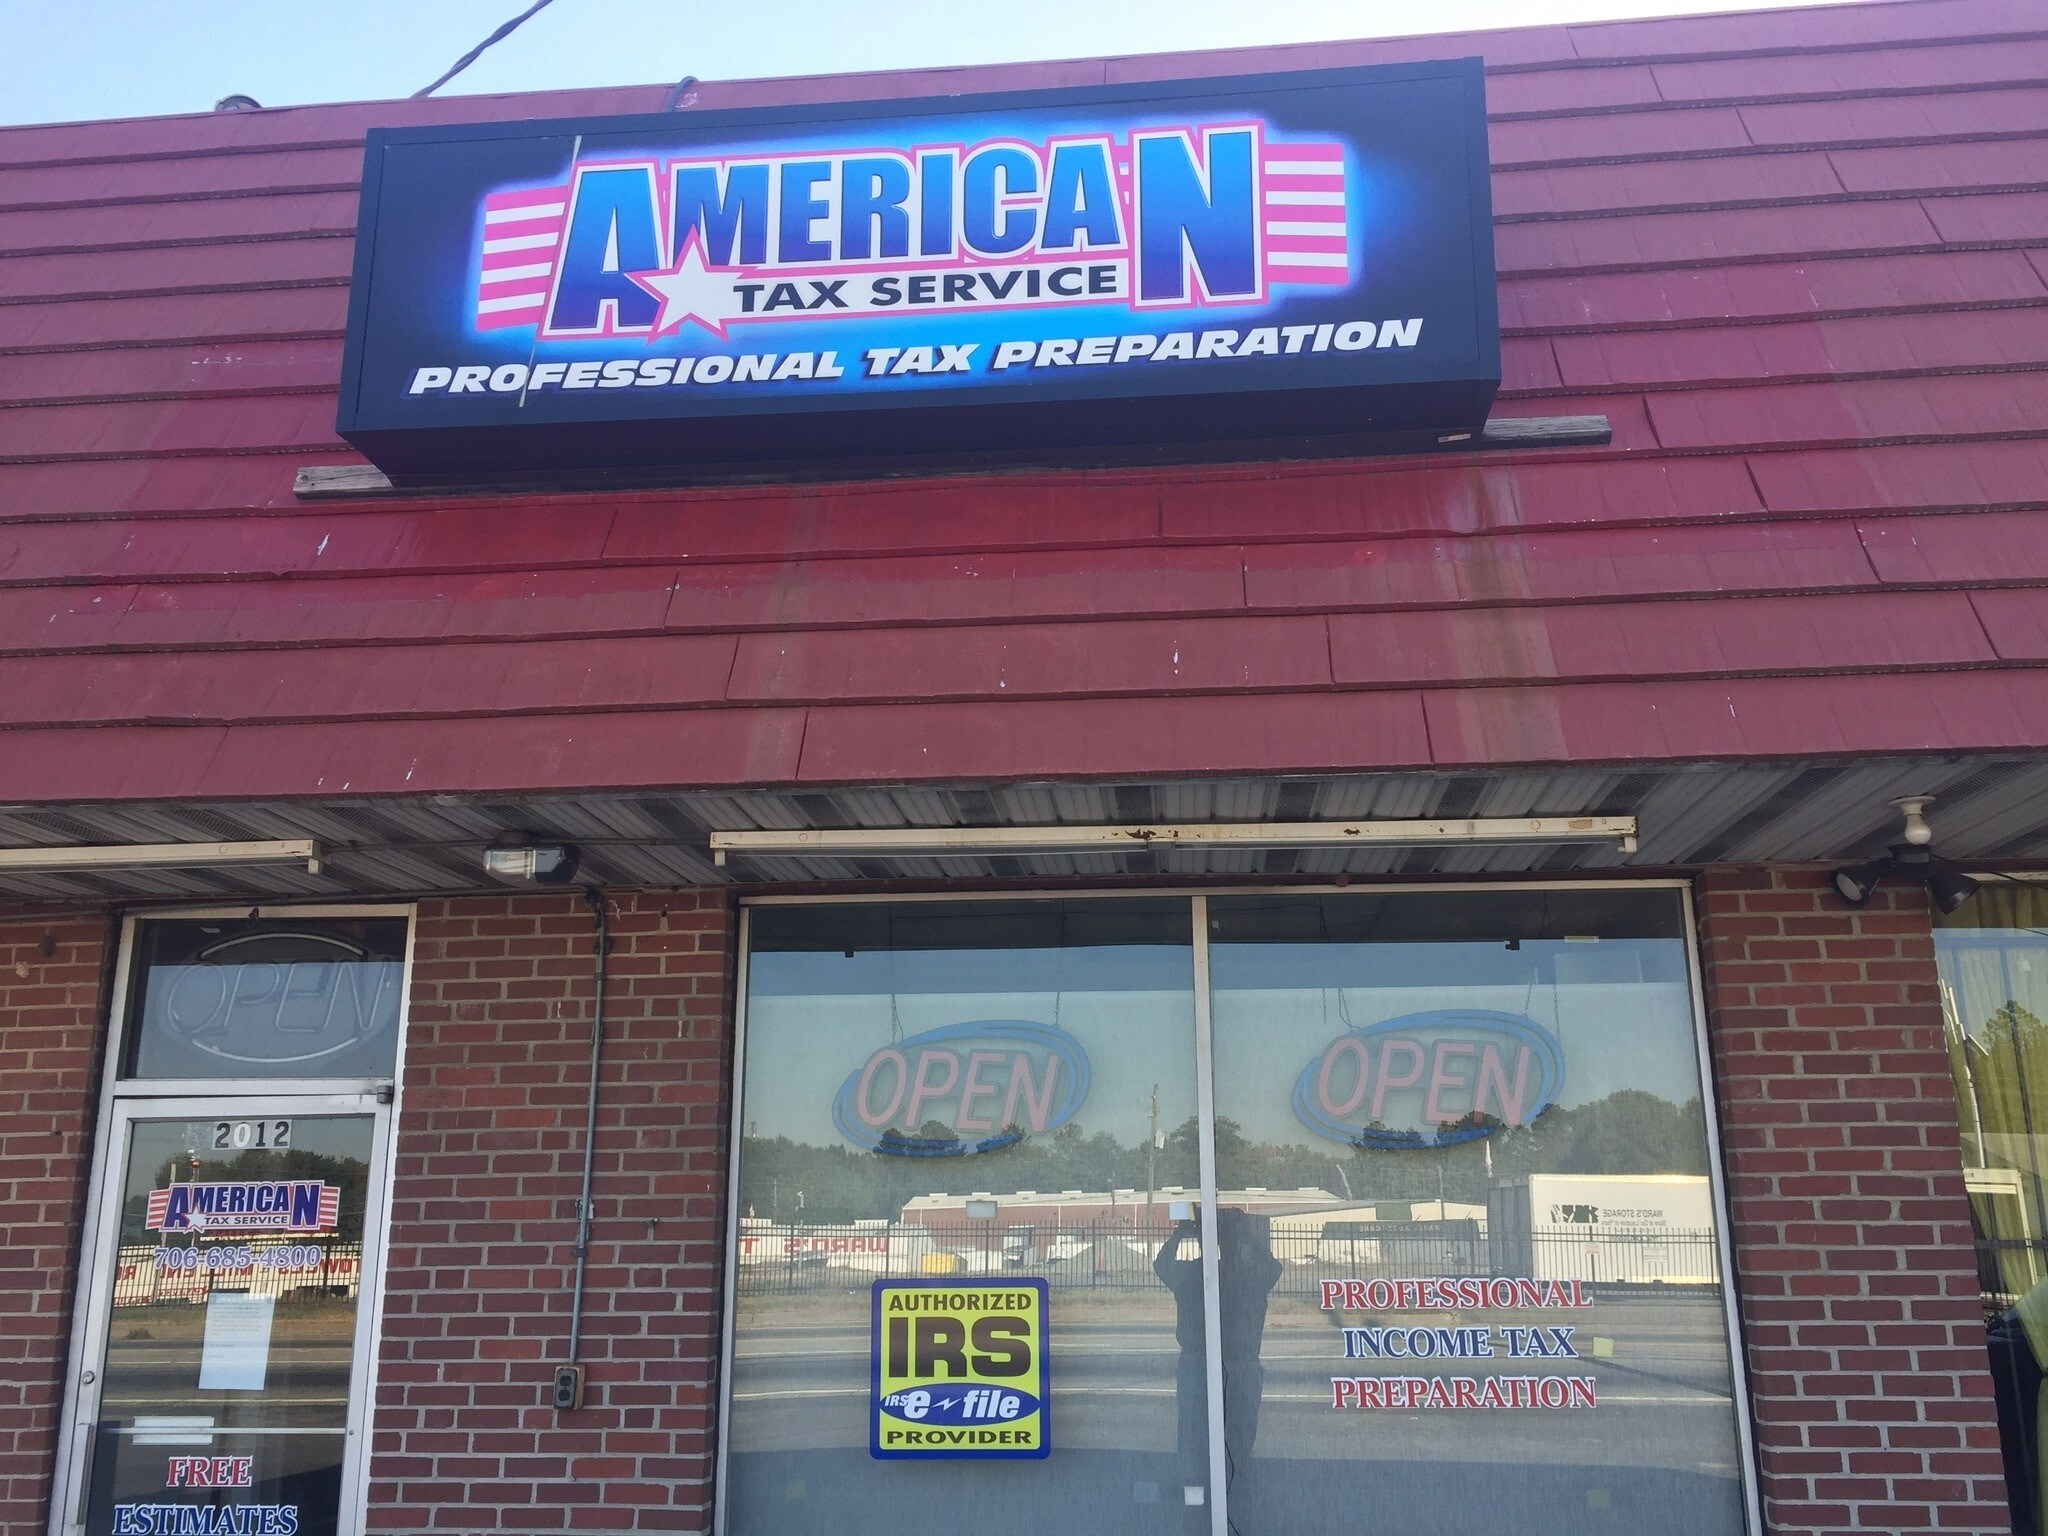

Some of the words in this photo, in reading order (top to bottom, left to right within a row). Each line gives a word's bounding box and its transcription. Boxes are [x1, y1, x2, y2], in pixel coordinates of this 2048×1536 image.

[545, 126, 1262, 333] AMERICAN
[733, 279, 850, 313] TAX
[869, 264, 1118, 306] SERVICE
[408, 349, 845, 395] PROFESSIONAL
[866, 343, 981, 376] TAX
[993, 317, 1424, 369] PREPARATION
[166, 955, 392, 1034] OPEN
[856, 1048, 1060, 1134] OPEN
[1318, 1036, 1531, 1127] OPEN
[214, 1121, 290, 1149] 2012
[163, 1183, 320, 1229] AMERICAN
[204, 1216, 230, 1225] TAX
[233, 1215, 288, 1225] SERVICE
[153, 1244, 322, 1270] 706-685-4800
[888, 1293, 1032, 1312] AUTHORIZED
[1320, 1277, 1594, 1310] PROFESSIONAL
[888, 1315, 1031, 1378] IRS
[1341, 1326, 1493, 1359] INCOME
[1500, 1326, 1579, 1359] TAX
[961, 1389, 1021, 1419] file
[1330, 1375, 1597, 1409] PREPARATION
[886, 1430, 1032, 1445] PROVIDER
[166, 1455, 253, 1487] FREE
[112, 1502, 299, 1536] ESTIMATES
